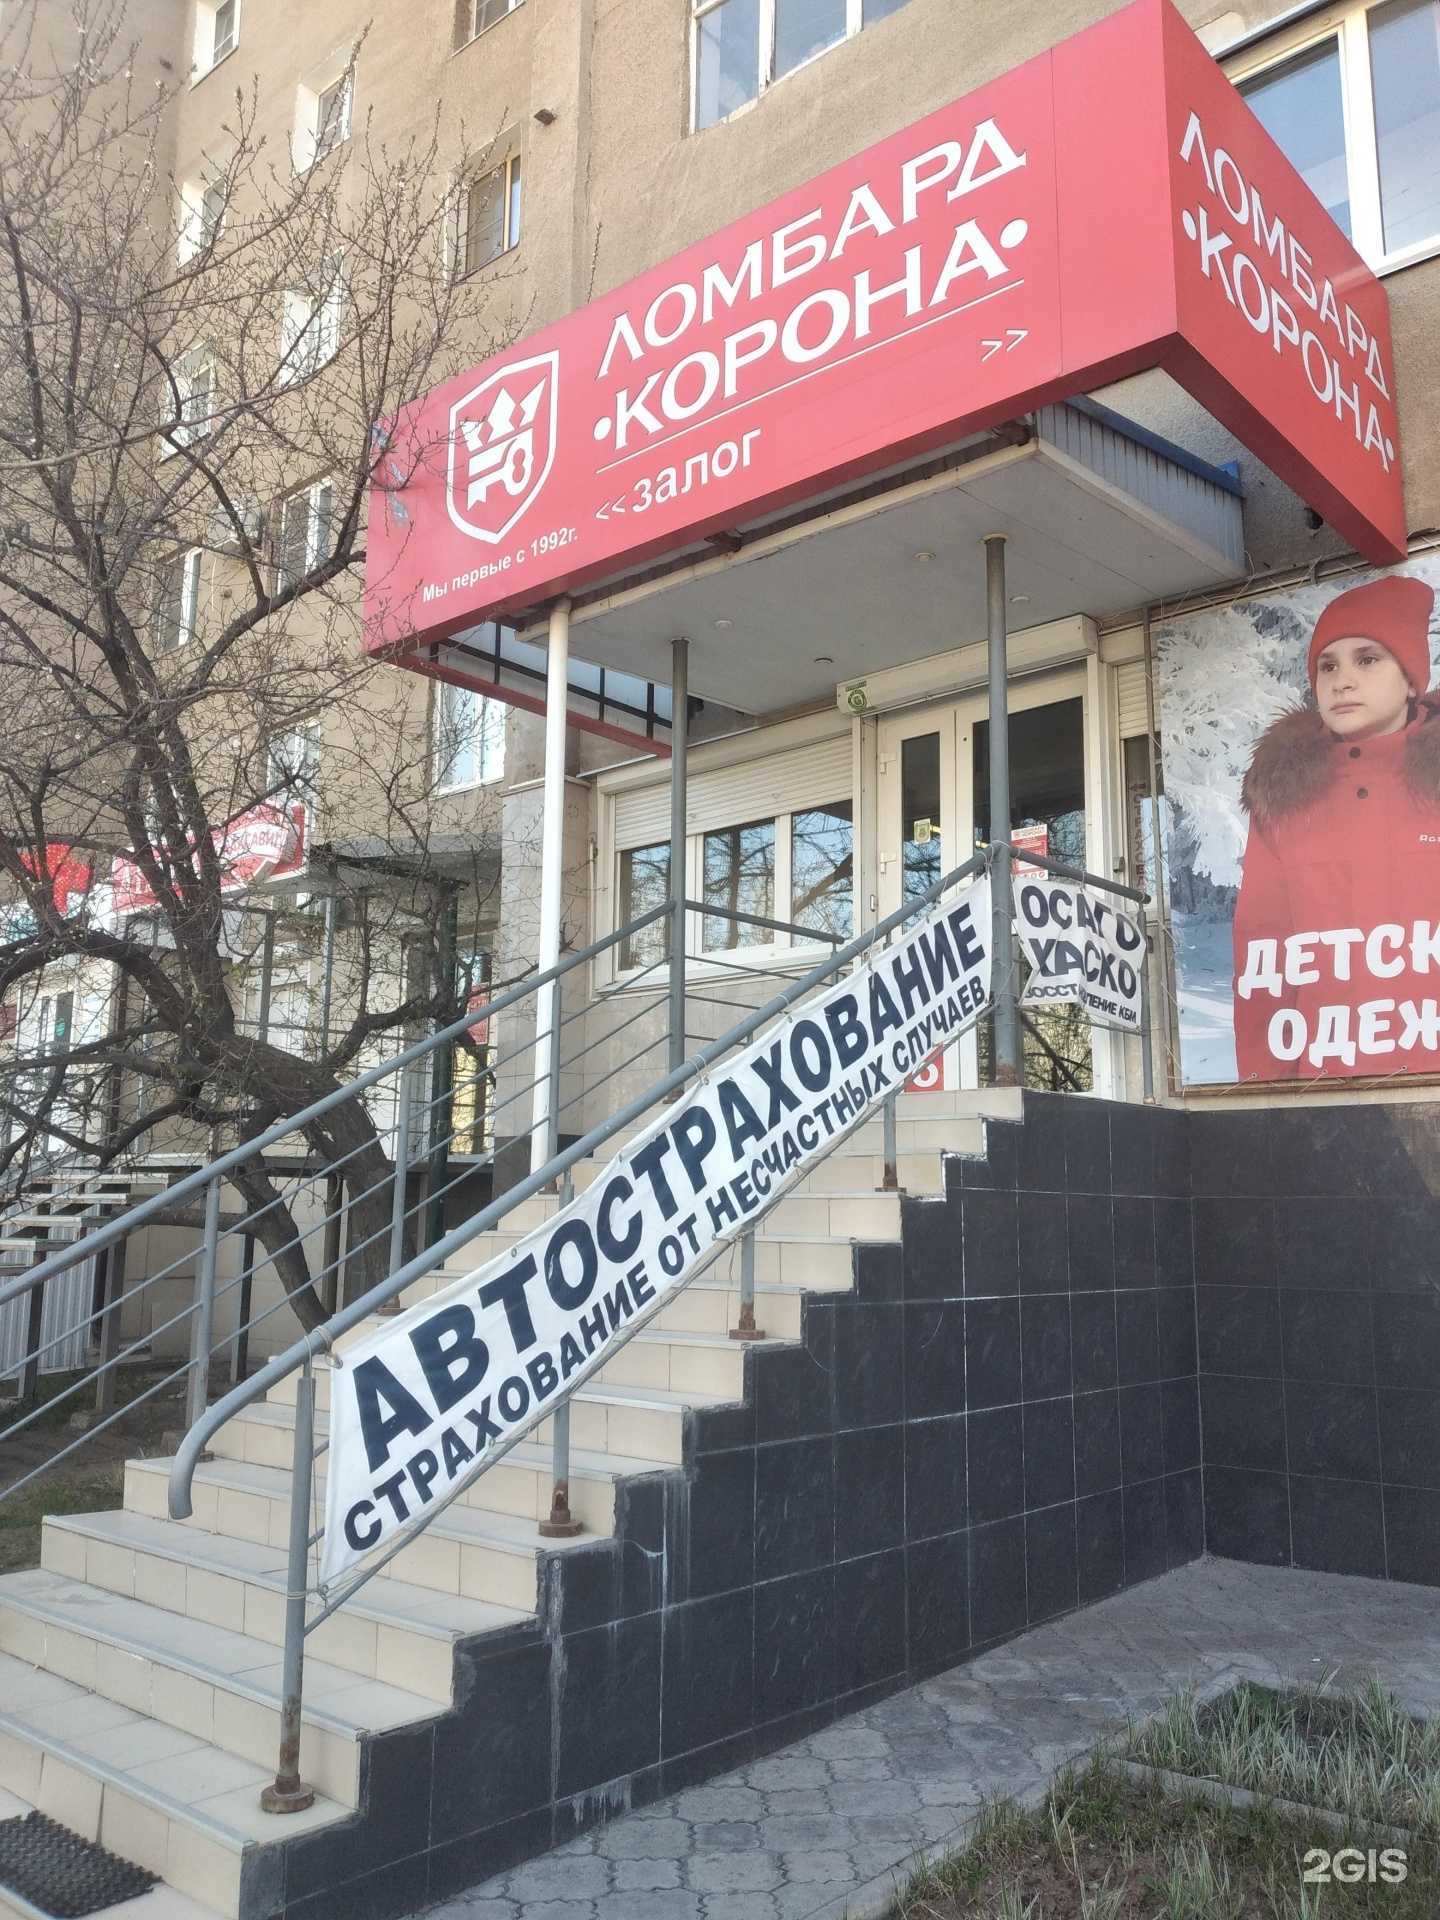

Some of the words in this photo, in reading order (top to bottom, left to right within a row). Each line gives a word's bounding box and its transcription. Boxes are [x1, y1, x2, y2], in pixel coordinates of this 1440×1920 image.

[596, 118, 1028, 377] ЛОМБАРД
[1180, 111, 1391, 400] ЛОМБАРД
[423, 582, 448, 602] Мы
[452, 556, 512, 591] первые
[530, 527, 578, 558] 1992г.
[1020, 885, 1141, 952] ОСАГО
[344, 1260, 657, 1551] СТРАХОВАНИЕ
[658, 1217, 702, 1275] ОТ
[706, 1055, 891, 1232] НЕСЧАСТНЫХ
[892, 975, 986, 1073] СЛУЧАЕВ
[352, 902, 986, 1474] АВТОСТРАХОВАНИЕ
